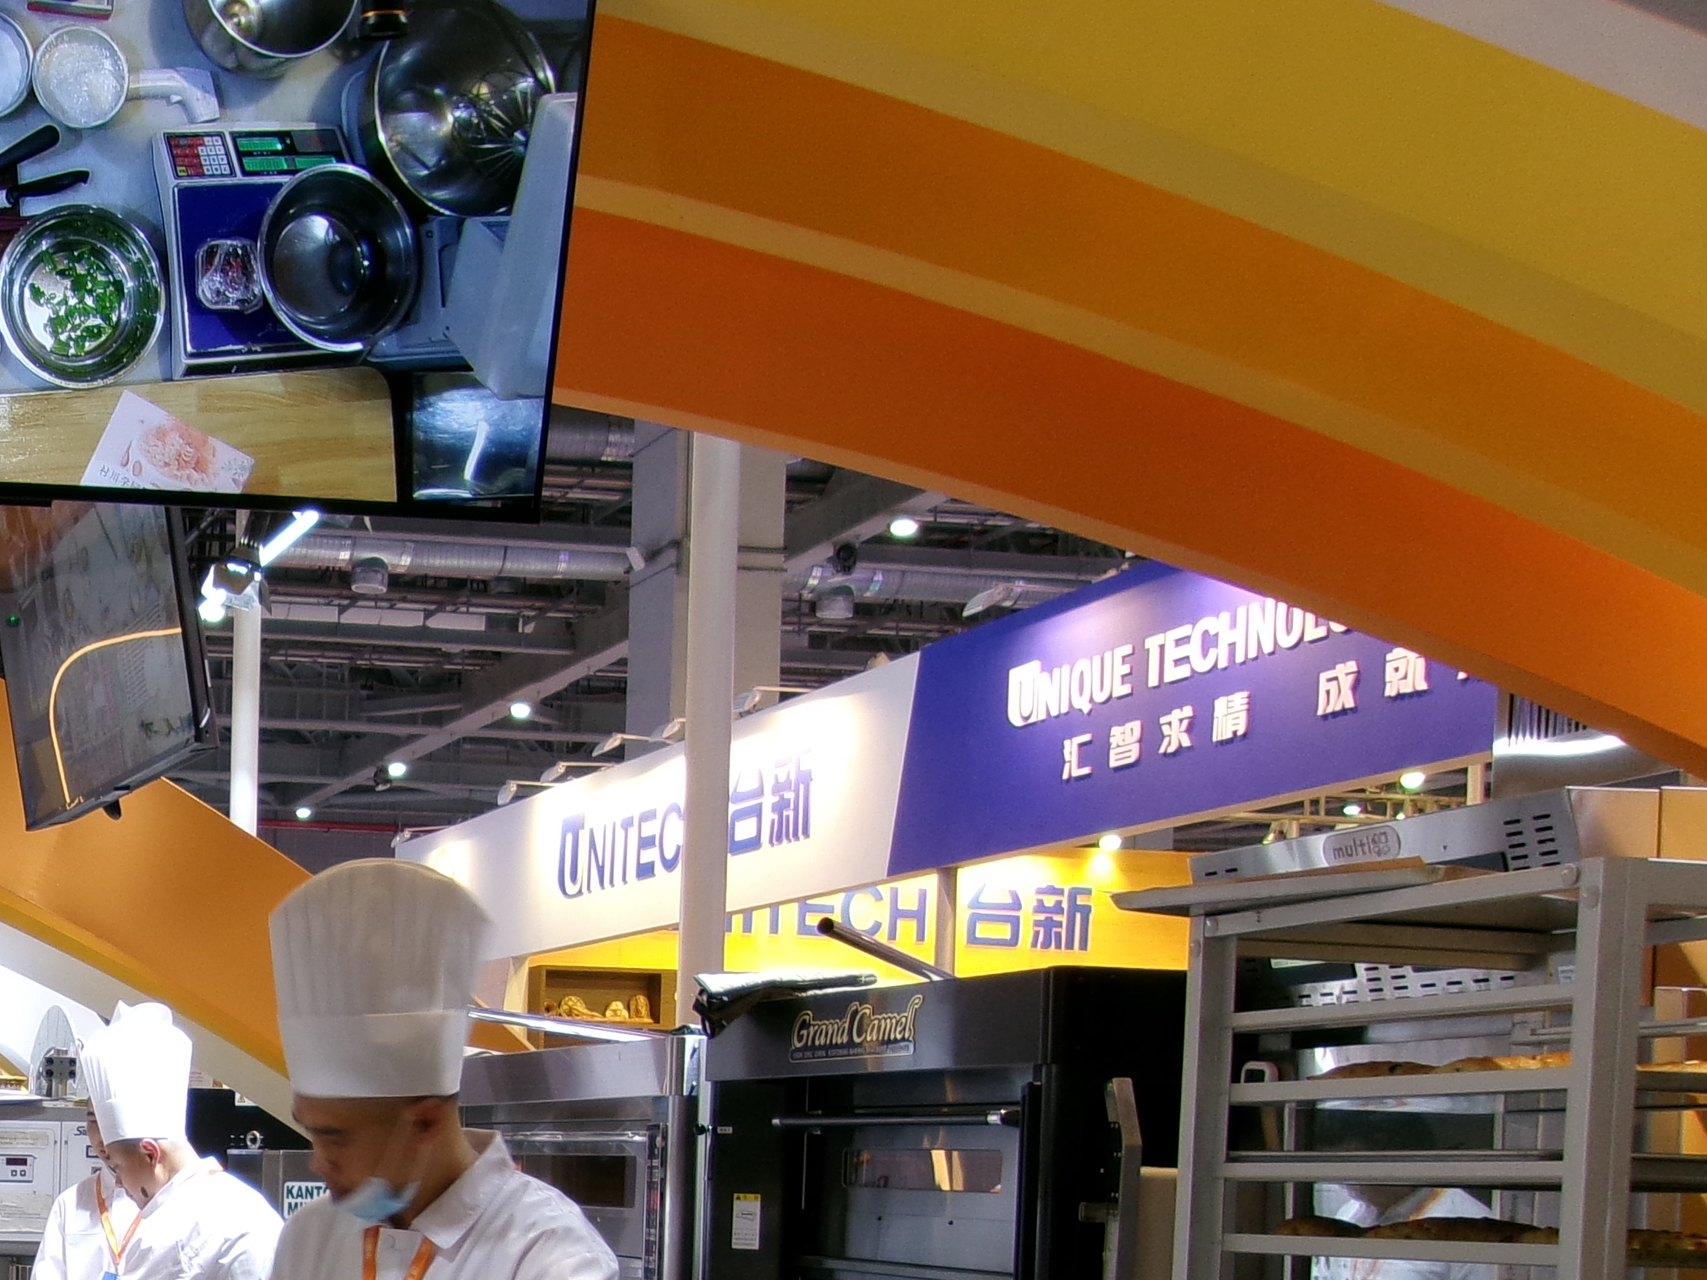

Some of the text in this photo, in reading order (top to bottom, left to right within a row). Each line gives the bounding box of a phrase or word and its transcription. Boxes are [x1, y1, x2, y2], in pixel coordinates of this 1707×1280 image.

[1007, 643, 1135, 727] UNIQUE
[1061, 691, 1251, 781] 汇智求精
[728, 750, 814, 857] 台新
[558, 802, 684, 899] UNITEC
[1332, 837, 1371, 860] multi
[966, 883, 1093, 951] 台新
[793, 997, 921, 1049] Grand Camel
